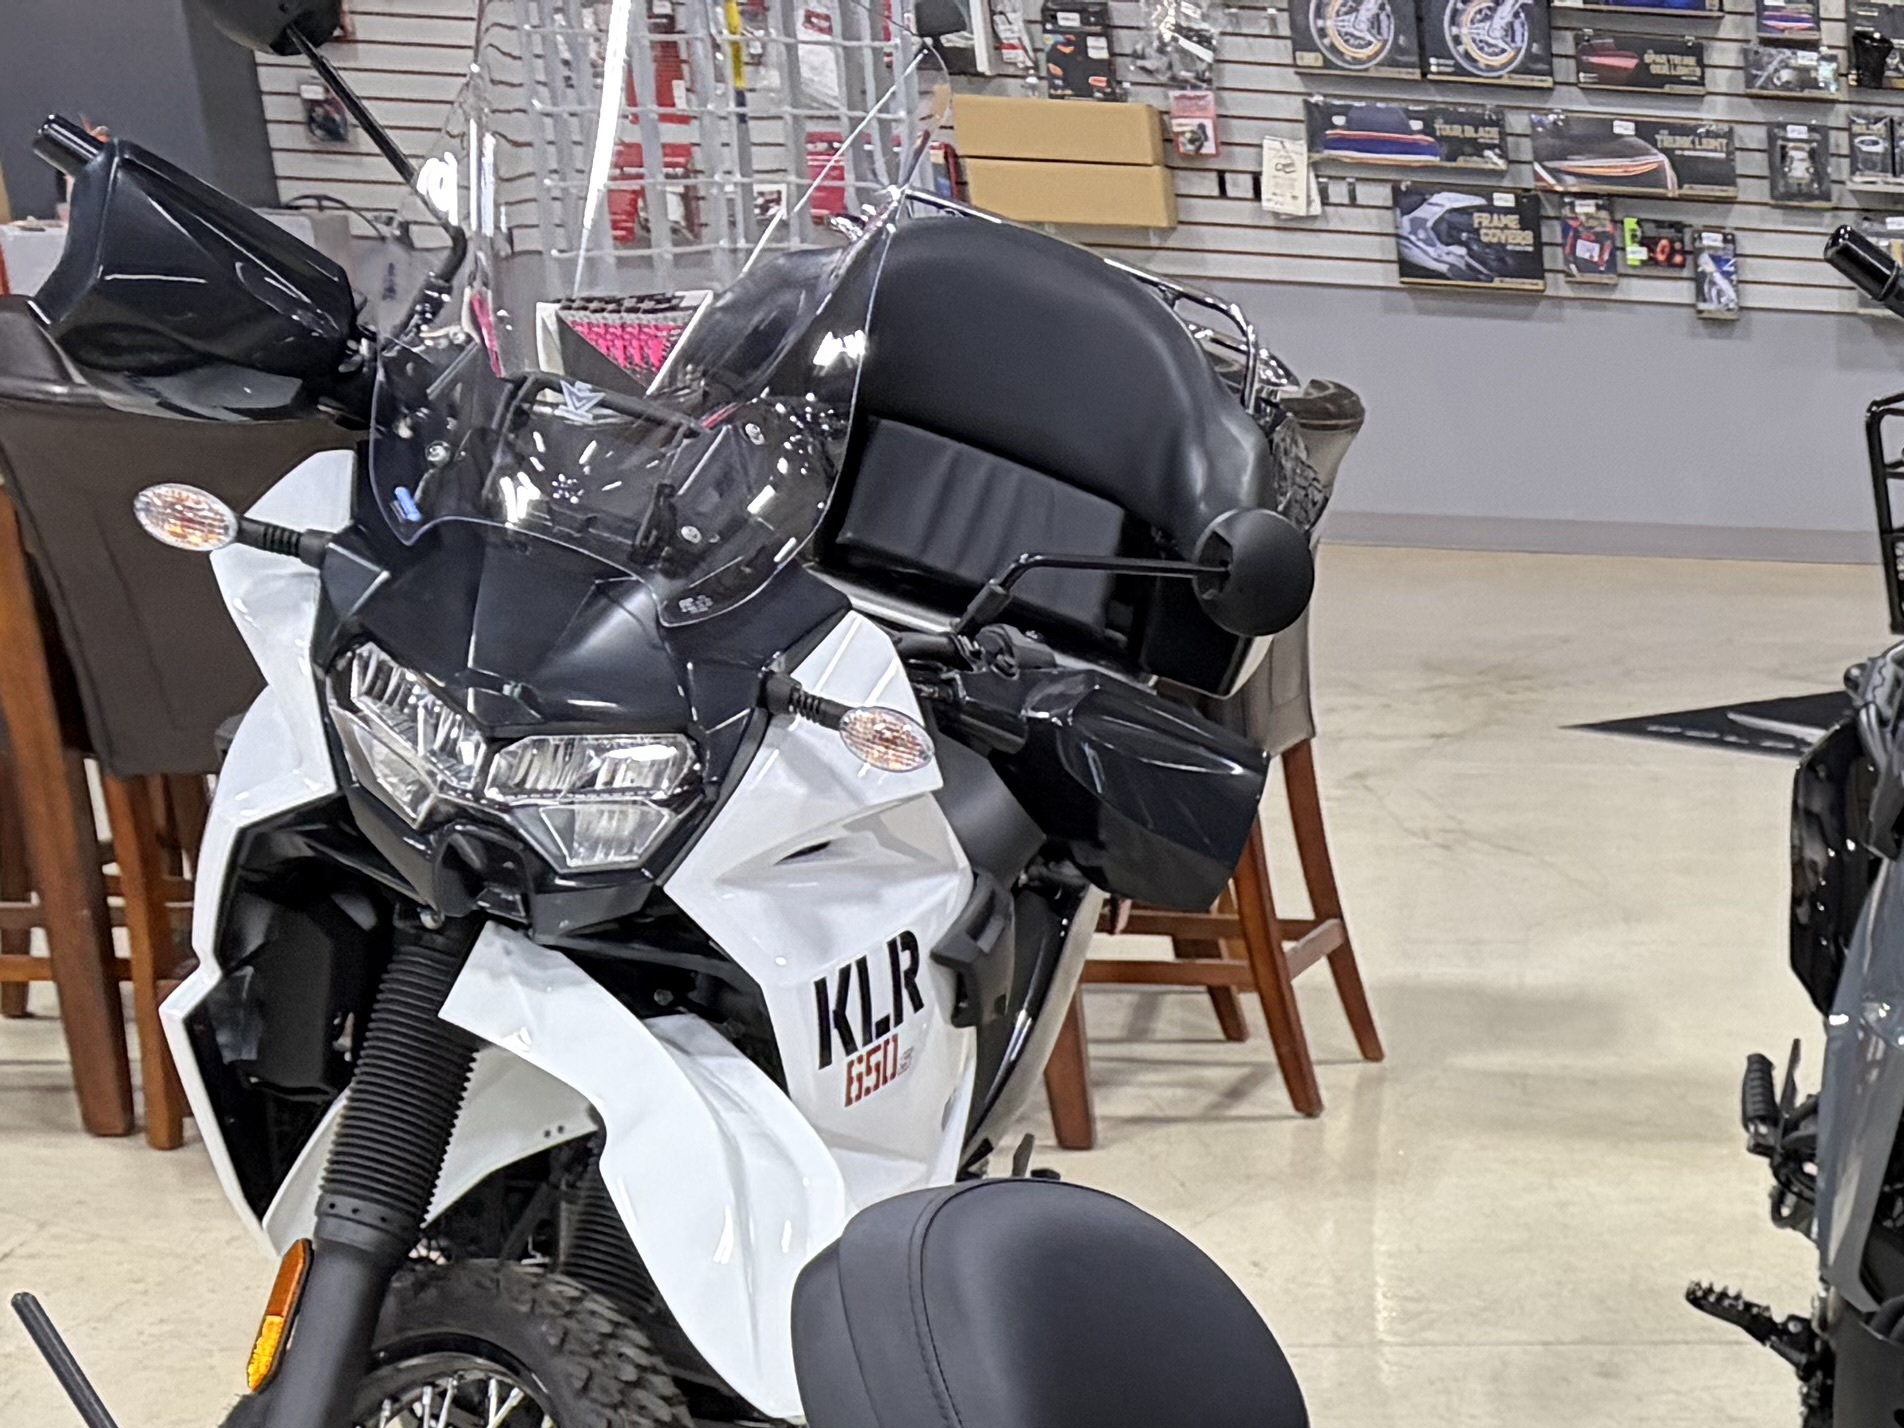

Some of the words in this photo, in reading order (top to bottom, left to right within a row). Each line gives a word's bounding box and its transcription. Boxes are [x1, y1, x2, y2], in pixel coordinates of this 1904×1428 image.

[1473, 212, 1520, 228] FRAME
[813, 929, 926, 1071] KLR
[844, 1032, 900, 1109] 650
